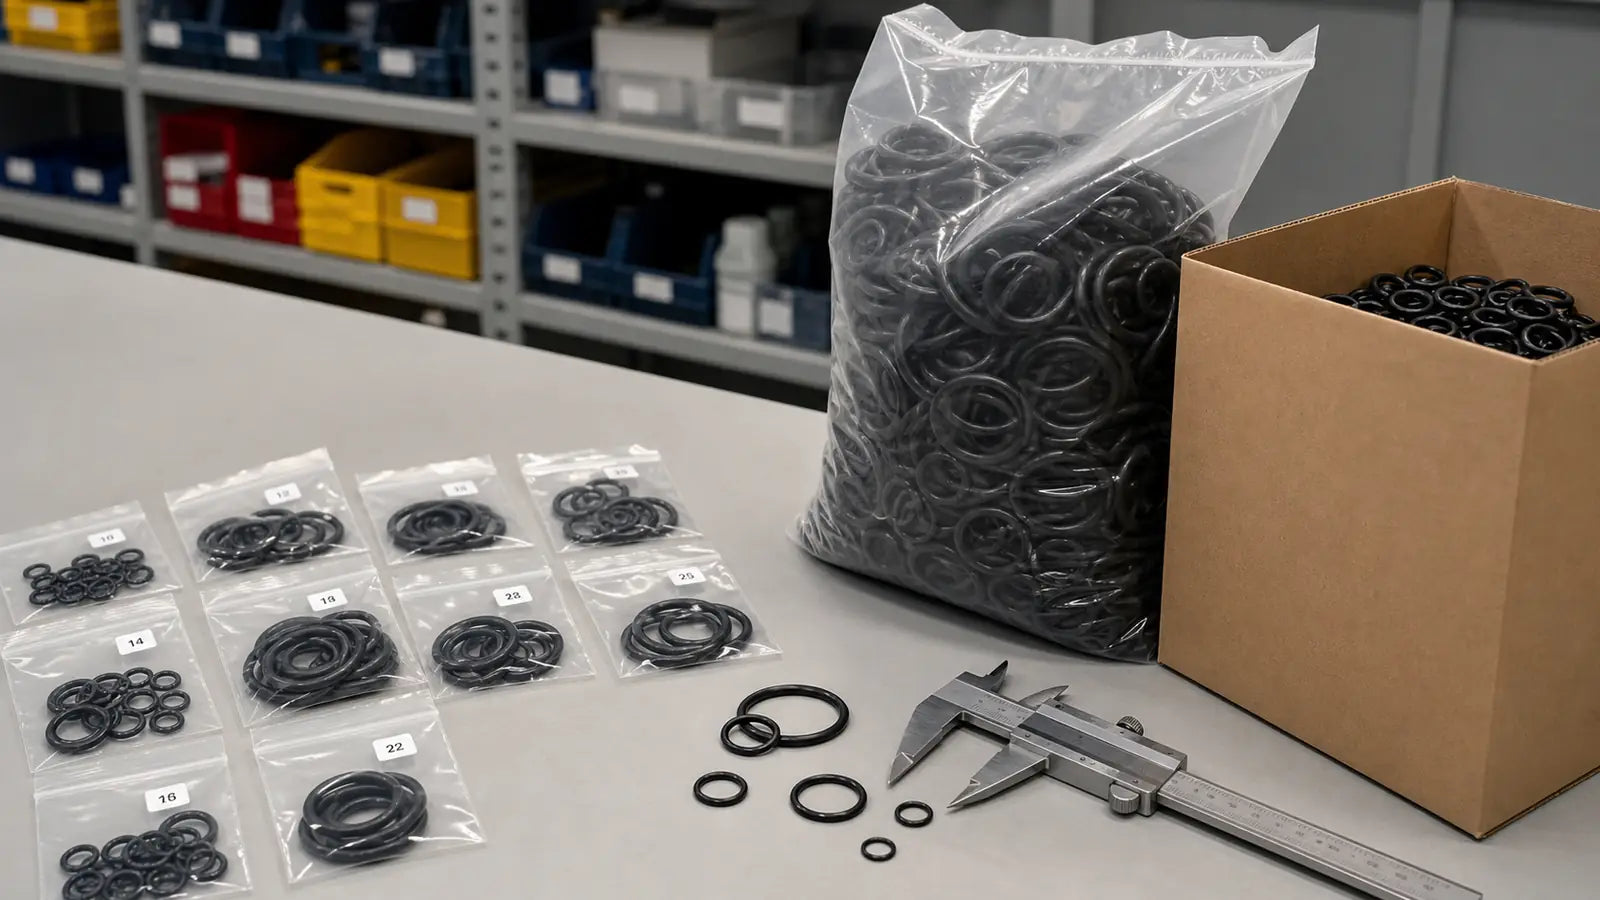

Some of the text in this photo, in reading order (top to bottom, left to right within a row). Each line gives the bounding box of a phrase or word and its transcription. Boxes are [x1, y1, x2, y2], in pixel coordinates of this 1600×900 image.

[128, 637, 144, 647] 14
[385, 742, 404, 753] 22
[158, 792, 177, 804] 16
